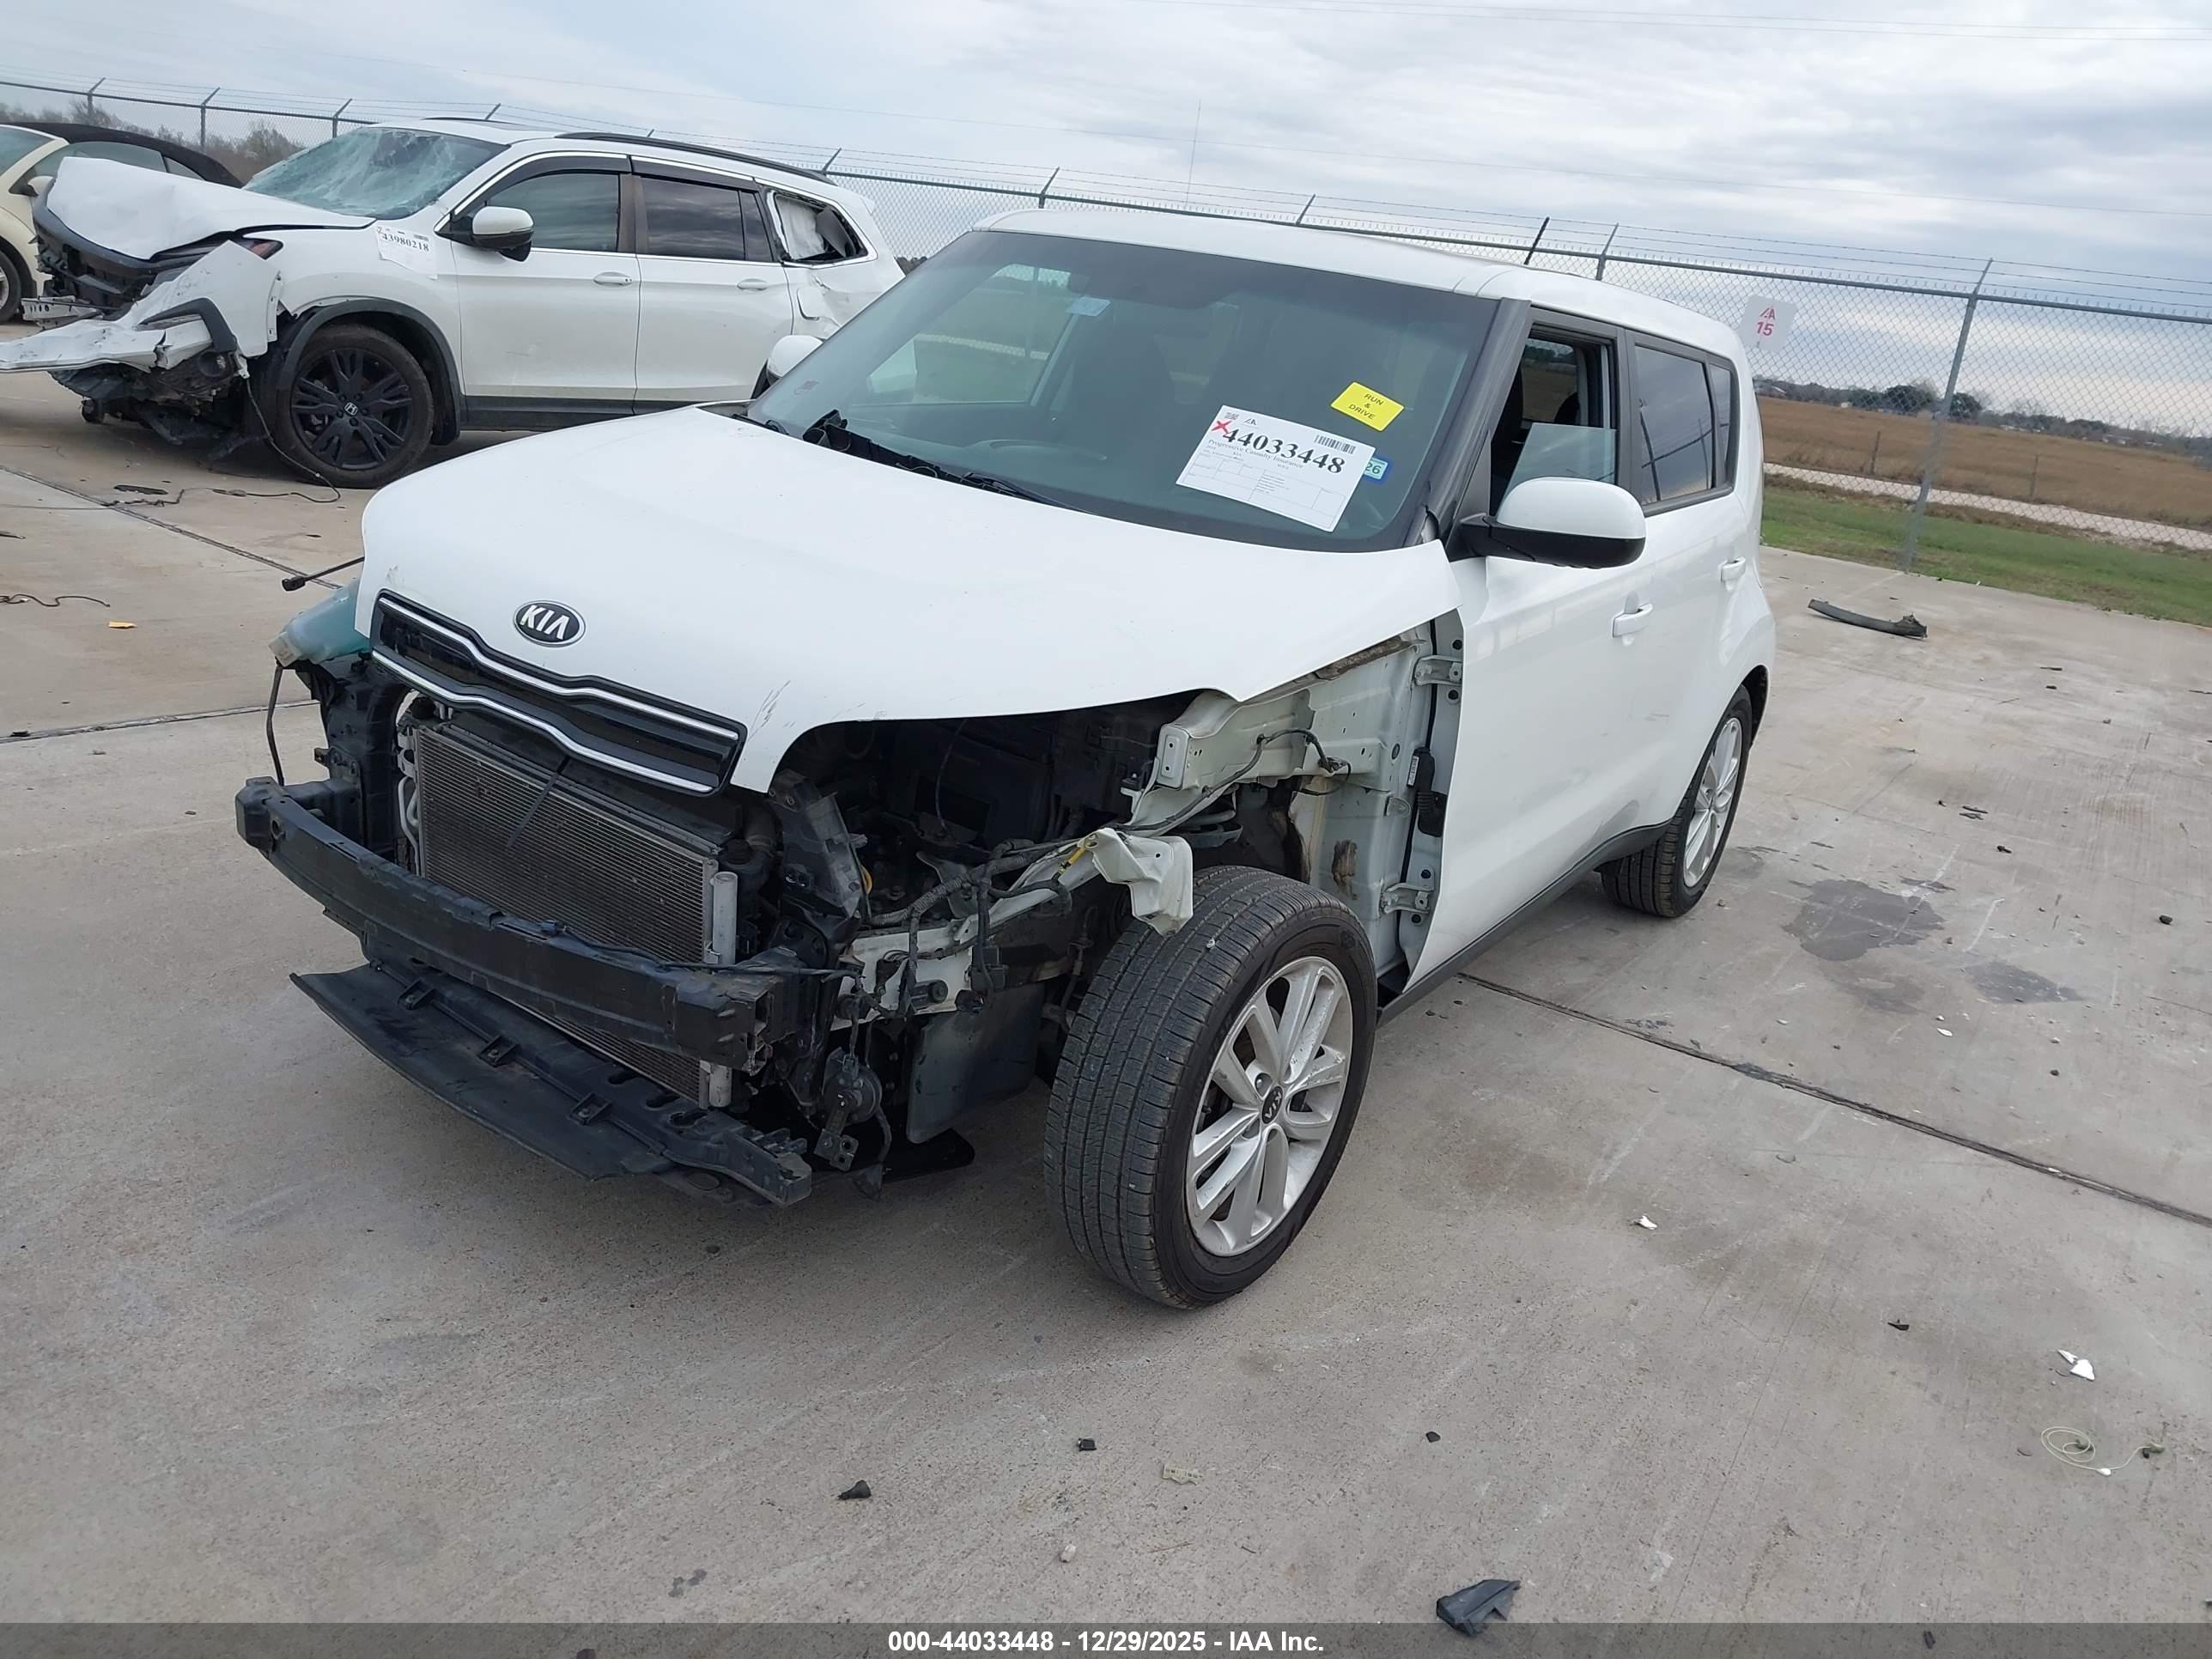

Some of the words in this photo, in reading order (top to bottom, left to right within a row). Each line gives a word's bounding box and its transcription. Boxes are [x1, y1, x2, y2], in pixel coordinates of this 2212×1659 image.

[381, 233, 430, 252] 43980218
[1756, 321, 1774, 337] 15
[1364, 393, 1384, 406] RUN
[1347, 404, 1376, 420] DRIVE
[1222, 428, 1346, 474] 44033448
[1273, 453, 1304, 469] Insurance
[1364, 462, 1382, 475] 26
[519, 604, 571, 641] KIA
[1264, 1091, 1282, 1119] KIA
